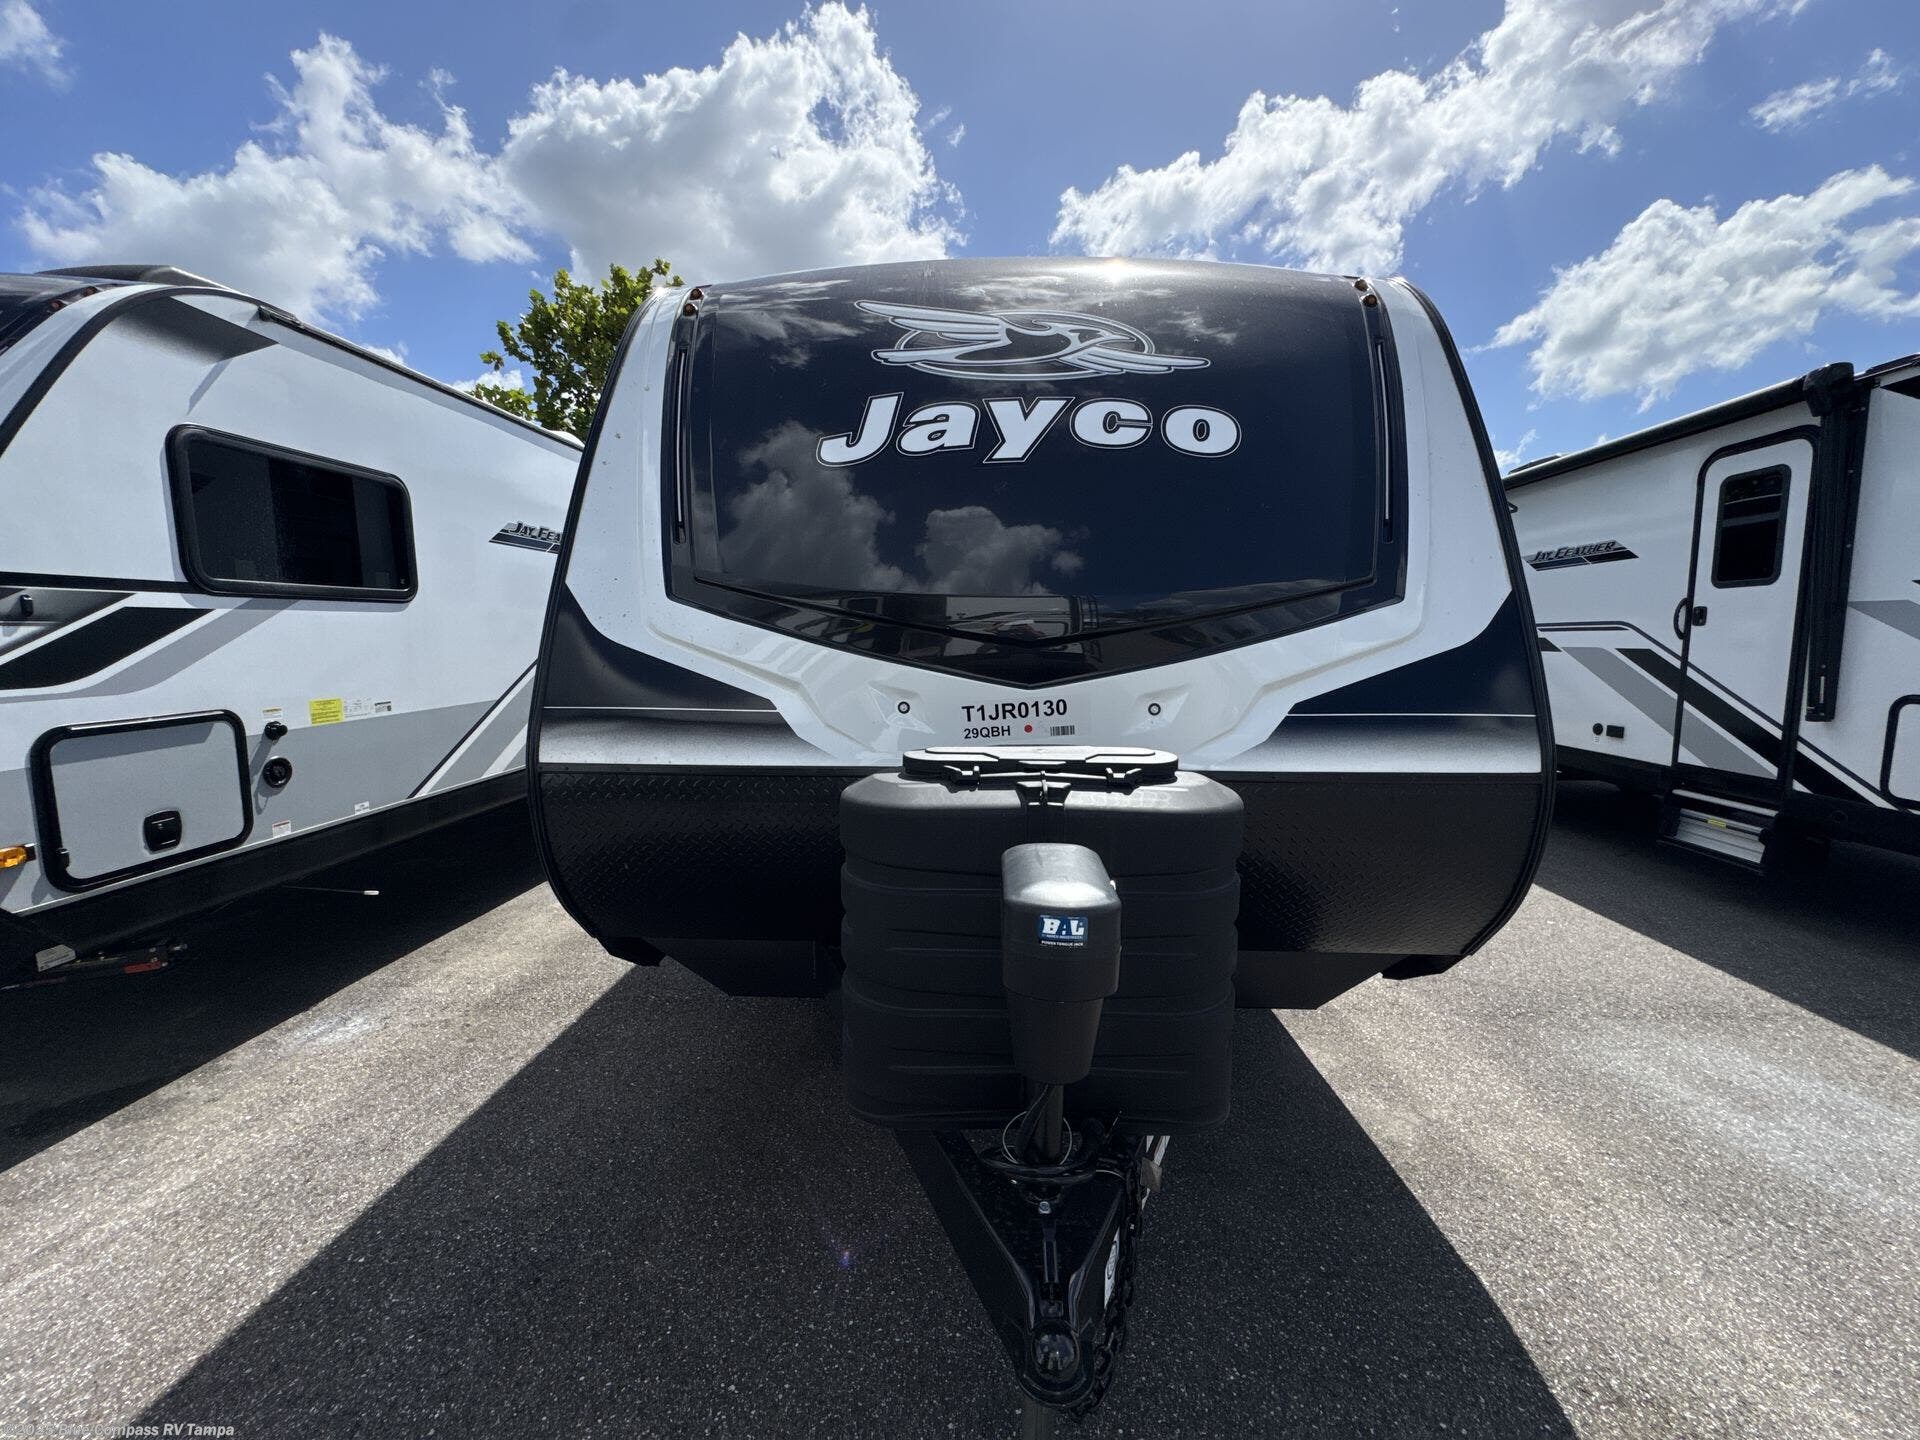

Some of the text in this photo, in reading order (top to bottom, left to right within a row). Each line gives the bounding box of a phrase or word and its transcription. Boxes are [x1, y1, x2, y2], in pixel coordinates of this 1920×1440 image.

[816, 392, 1242, 467] Jayco
[961, 699, 1067, 722] T1JR0130
[963, 725, 1011, 739] 29QBH
